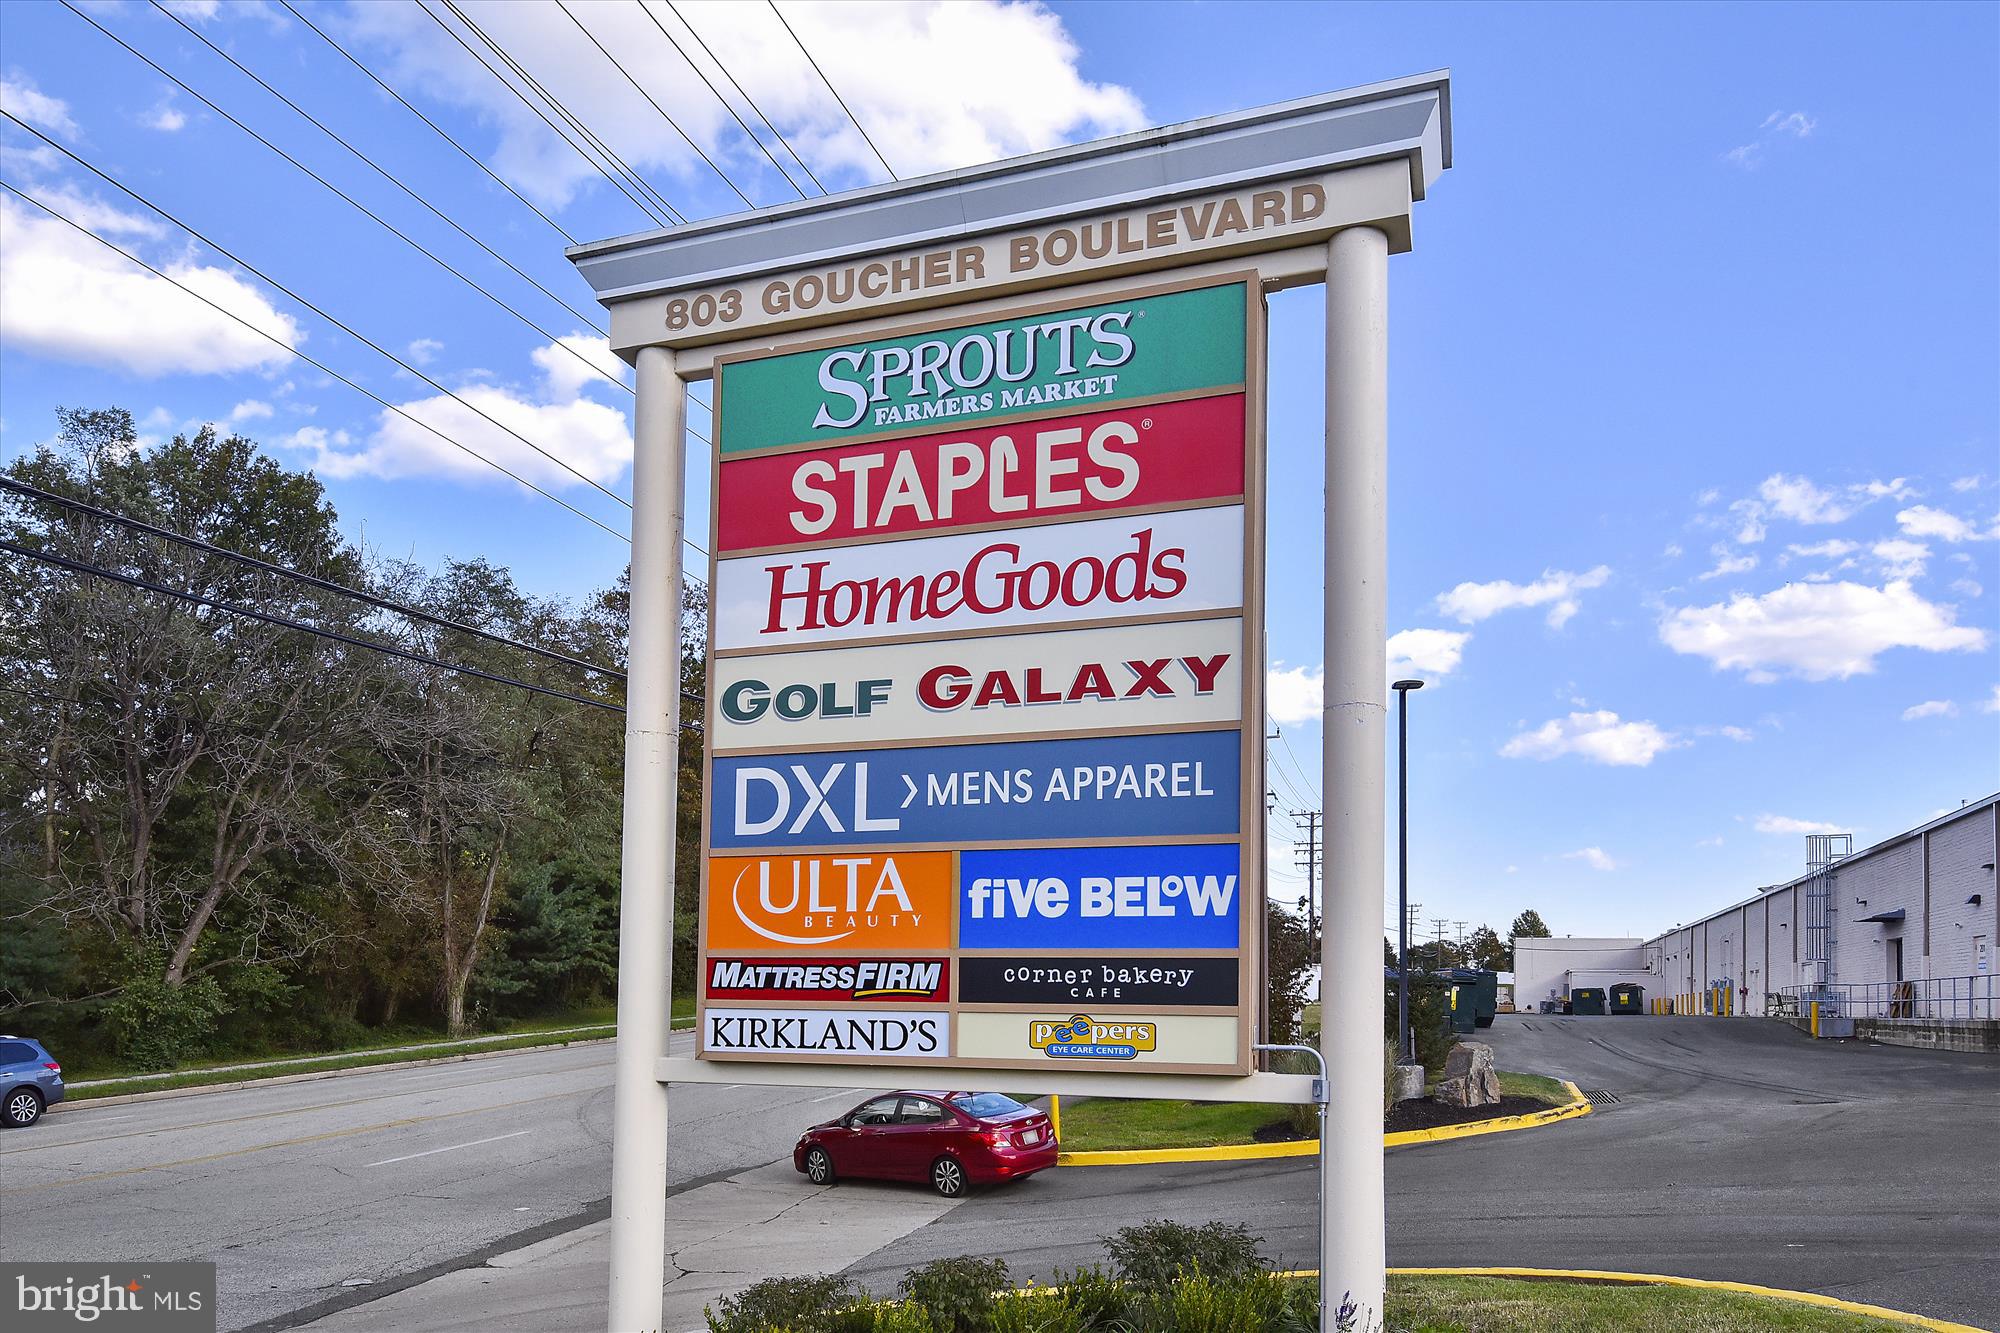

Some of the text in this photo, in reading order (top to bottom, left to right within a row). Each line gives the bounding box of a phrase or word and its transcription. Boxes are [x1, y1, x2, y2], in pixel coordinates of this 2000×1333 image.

[664, 182, 1328, 332] 803 GOUCHER BOULEVARD
[811, 309, 1136, 430] SPROUTS
[874, 374, 1119, 427] FARMERS MARKET
[788, 420, 1140, 536] STAPLES
[759, 527, 1188, 634] HomeGoods
[720, 653, 1232, 723] GOLF GALAXY
[734, 760, 1215, 836] DXL MENS APPAREL
[758, 857, 914, 914] ULTA
[1080, 874, 1238, 918] BELOW
[804, 914, 923, 928] BEAUTY
[1003, 965, 1195, 988] corner bakery
[1070, 987, 1122, 999] CAFE
[711, 1017, 937, 1051] KIRKLAND'S
[1036, 1021, 1150, 1044] peepers
[1052, 1045, 1131, 1056] EYE CARE CENTER
